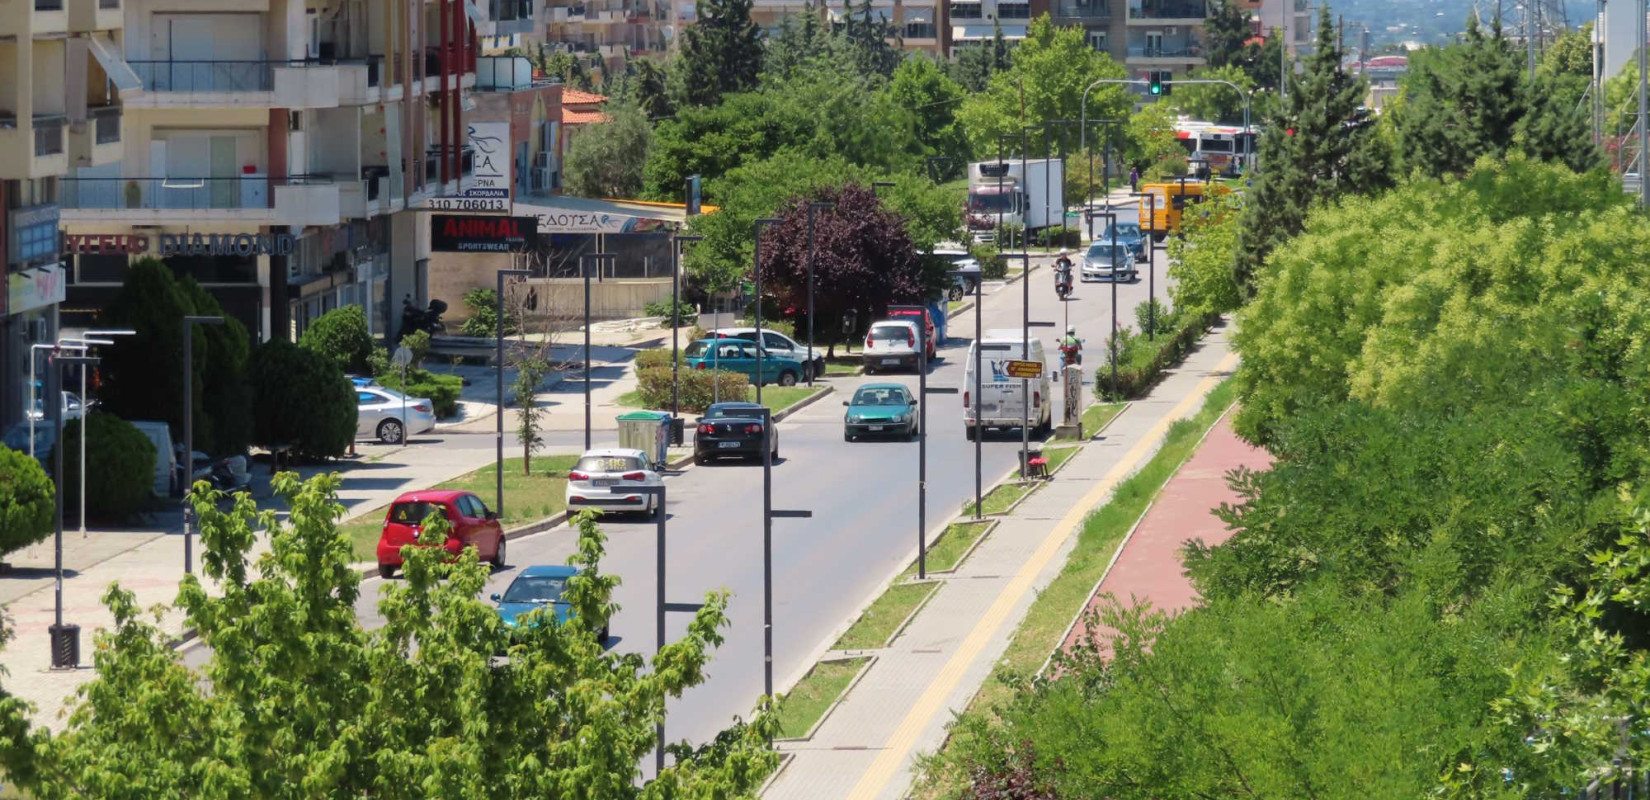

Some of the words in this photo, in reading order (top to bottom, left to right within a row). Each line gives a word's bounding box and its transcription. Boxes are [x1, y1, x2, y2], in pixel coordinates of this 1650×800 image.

[456, 200, 504, 209] 706013
[444, 218, 525, 238] ANIMAL
[525, 213, 603, 228] ΕΔΟΥΣΑ
[159, 232, 296, 256] DIAMOND
[457, 242, 510, 250] SPORTSWEAR
